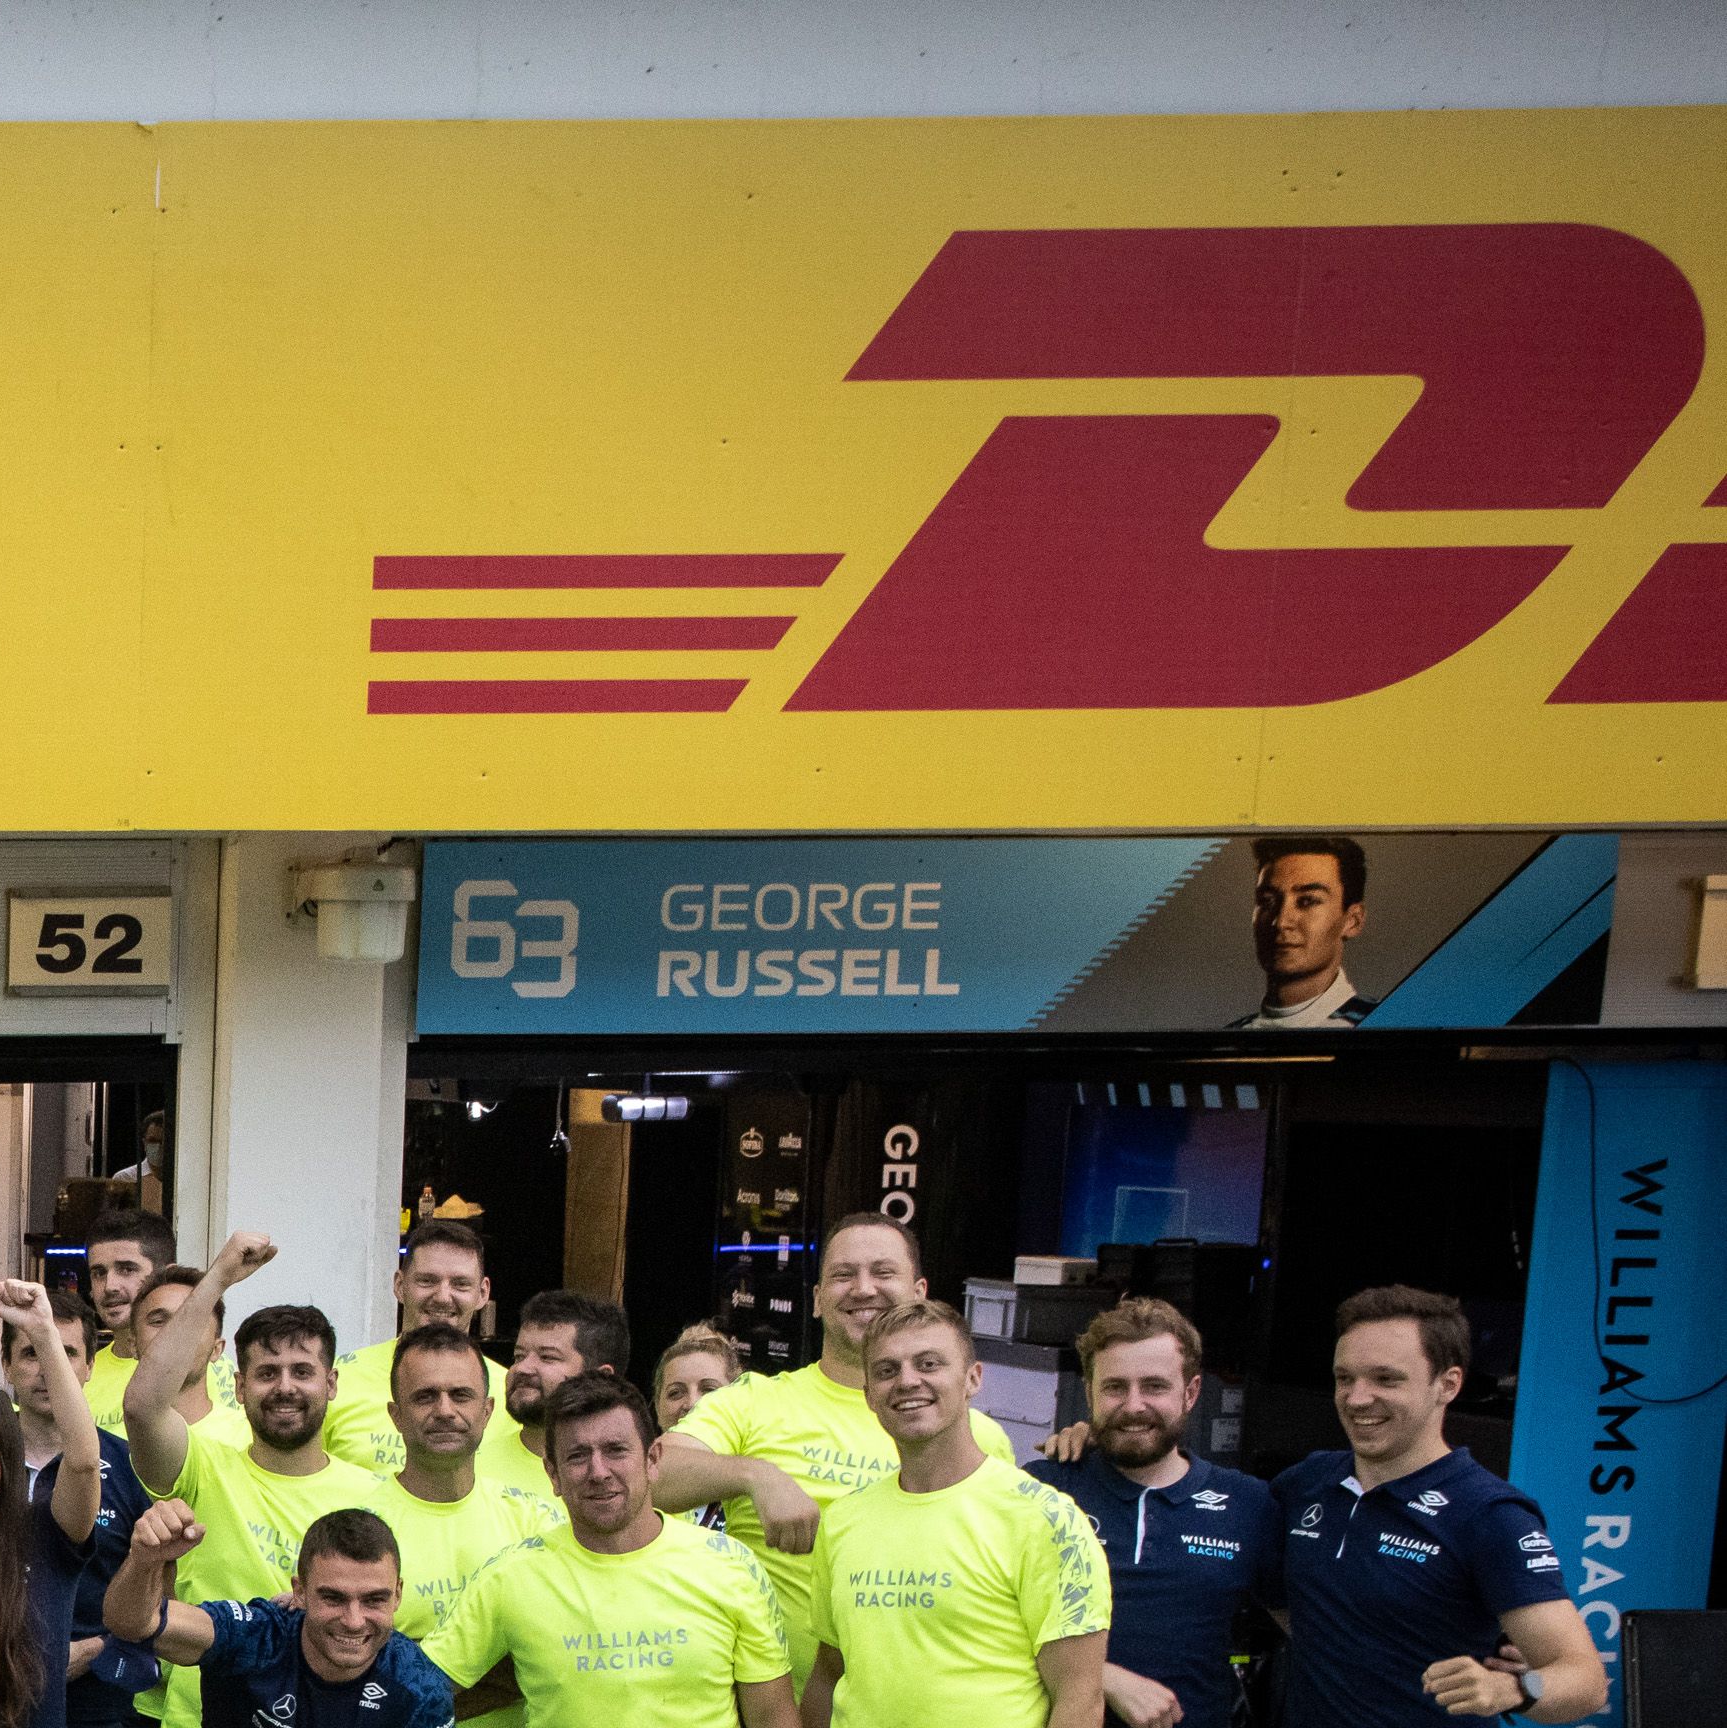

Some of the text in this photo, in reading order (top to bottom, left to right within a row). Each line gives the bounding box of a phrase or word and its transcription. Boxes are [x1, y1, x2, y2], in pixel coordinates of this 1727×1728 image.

[780, 222, 1727, 713] D
[660, 881, 942, 933] GEORGE
[35, 913, 143, 974] 52
[450, 879, 580, 998] 63
[656, 948, 960, 998] RUSSELL
[880, 1124, 920, 1224] GEO
[1589, 1158, 1669, 1495] WILLIAMS
[803, 1445, 900, 1473] WILLIAM
[1195, 1503, 1226, 1511] umbro
[1407, 1501, 1438, 1517] umbro
[1180, 1534, 1241, 1552] WILLIAMS
[1187, 1545, 1235, 1560] RACING
[1377, 1544, 1427, 1563] RACING
[1379, 1531, 1441, 1556] WILLIAMS
[849, 1569, 952, 1589] WILLIAMS
[855, 1591, 935, 1609] RACING
[562, 1628, 688, 1650] WILLIAMS
[576, 1650, 674, 1672] RACING
[359, 1700, 380, 1711] mbro
